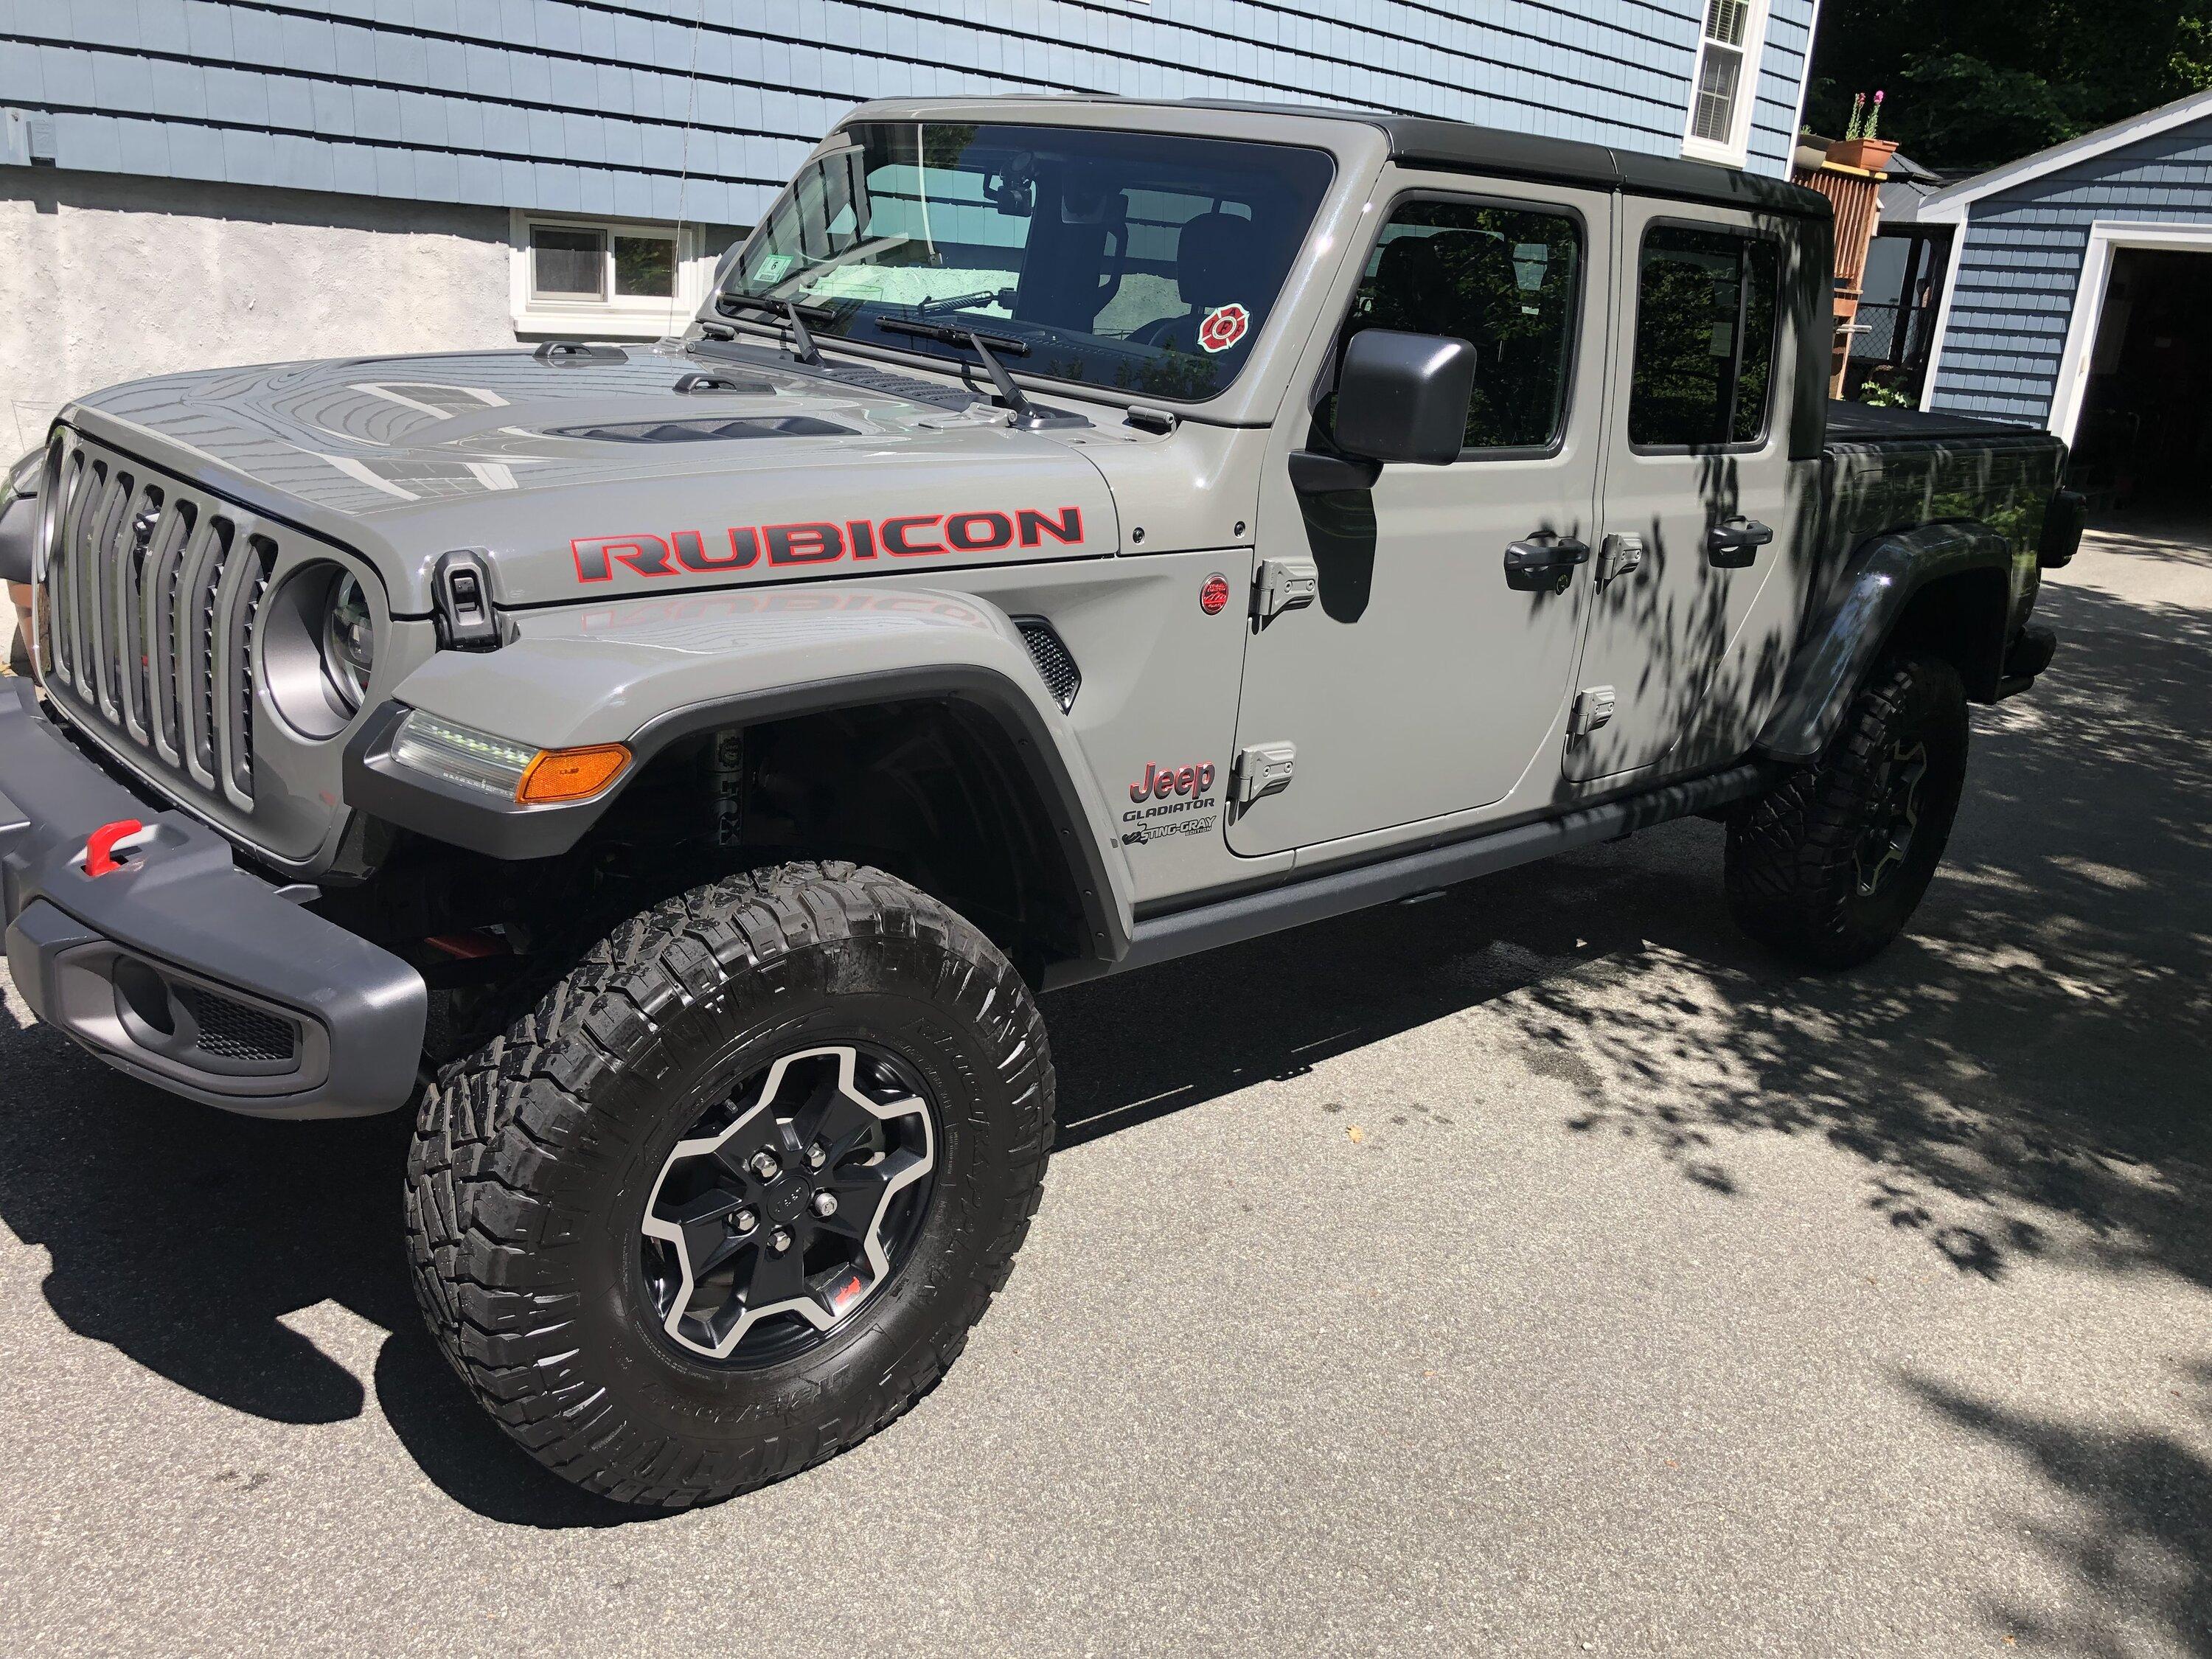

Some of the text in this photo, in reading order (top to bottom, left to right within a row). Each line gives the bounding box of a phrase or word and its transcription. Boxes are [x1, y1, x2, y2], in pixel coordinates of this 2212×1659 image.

[771, 261, 779, 270] 6
[571, 507, 1084, 582] RUBICON
[1130, 760, 1215, 804] Jeep
[1122, 798, 1215, 822] GLADIATOR
[1140, 815, 1217, 841] STING-GRAY
[1185, 826, 1213, 836] EDITION
